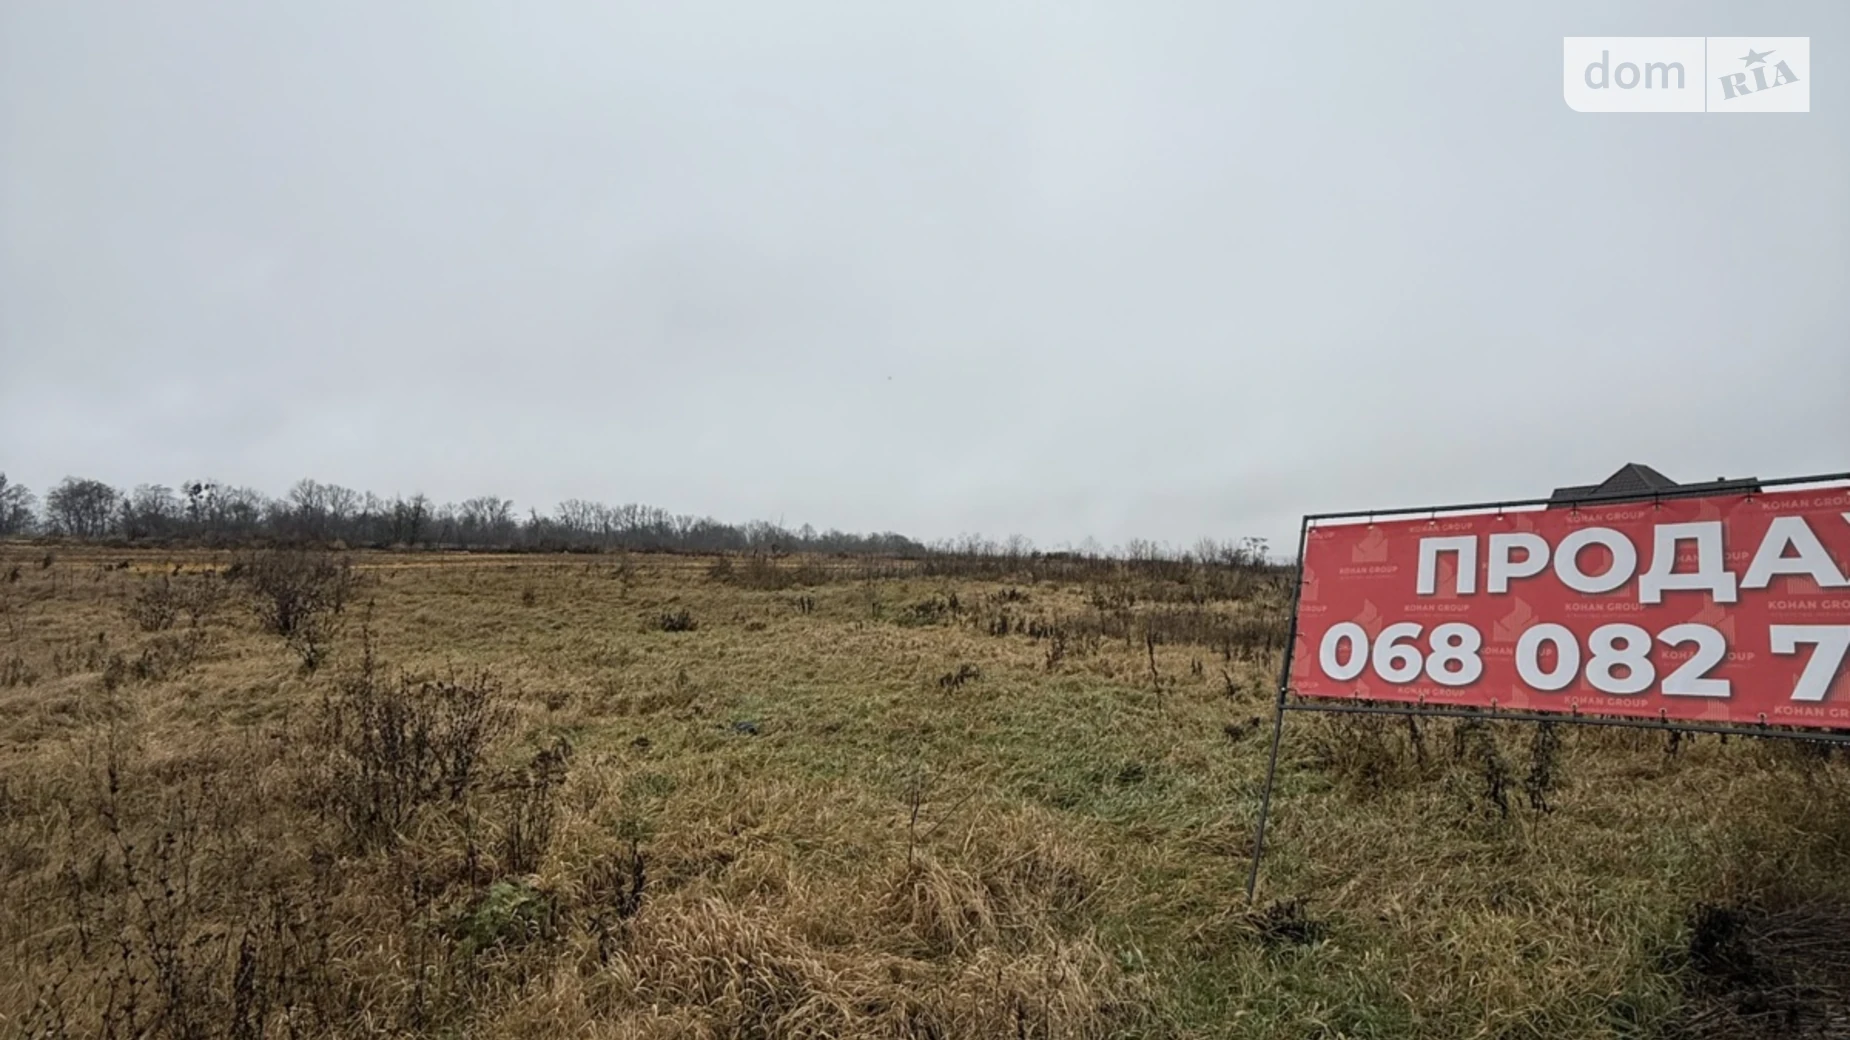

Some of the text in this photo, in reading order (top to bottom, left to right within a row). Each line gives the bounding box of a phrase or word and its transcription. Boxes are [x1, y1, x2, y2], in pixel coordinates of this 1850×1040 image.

[1762, 497, 1809, 510] KOHAN
[1605, 511, 1646, 521] GROUP
[1443, 522, 1473, 532] GROUP
[1416, 512, 1850, 604] ПРОДА
[1339, 565, 1399, 575] KOHAN GROUP
[1404, 604, 1471, 612] KOHAN GROUP
[1565, 602, 1647, 612] KOHAN GROUP
[1768, 600, 1817, 610] KOHAN
[1319, 621, 1850, 702] 068 082 7
[1432, 688, 1466, 697] GROUP
[1564, 696, 1649, 708] KOHAN GROUP
[1774, 705, 1825, 717] KOHAN
